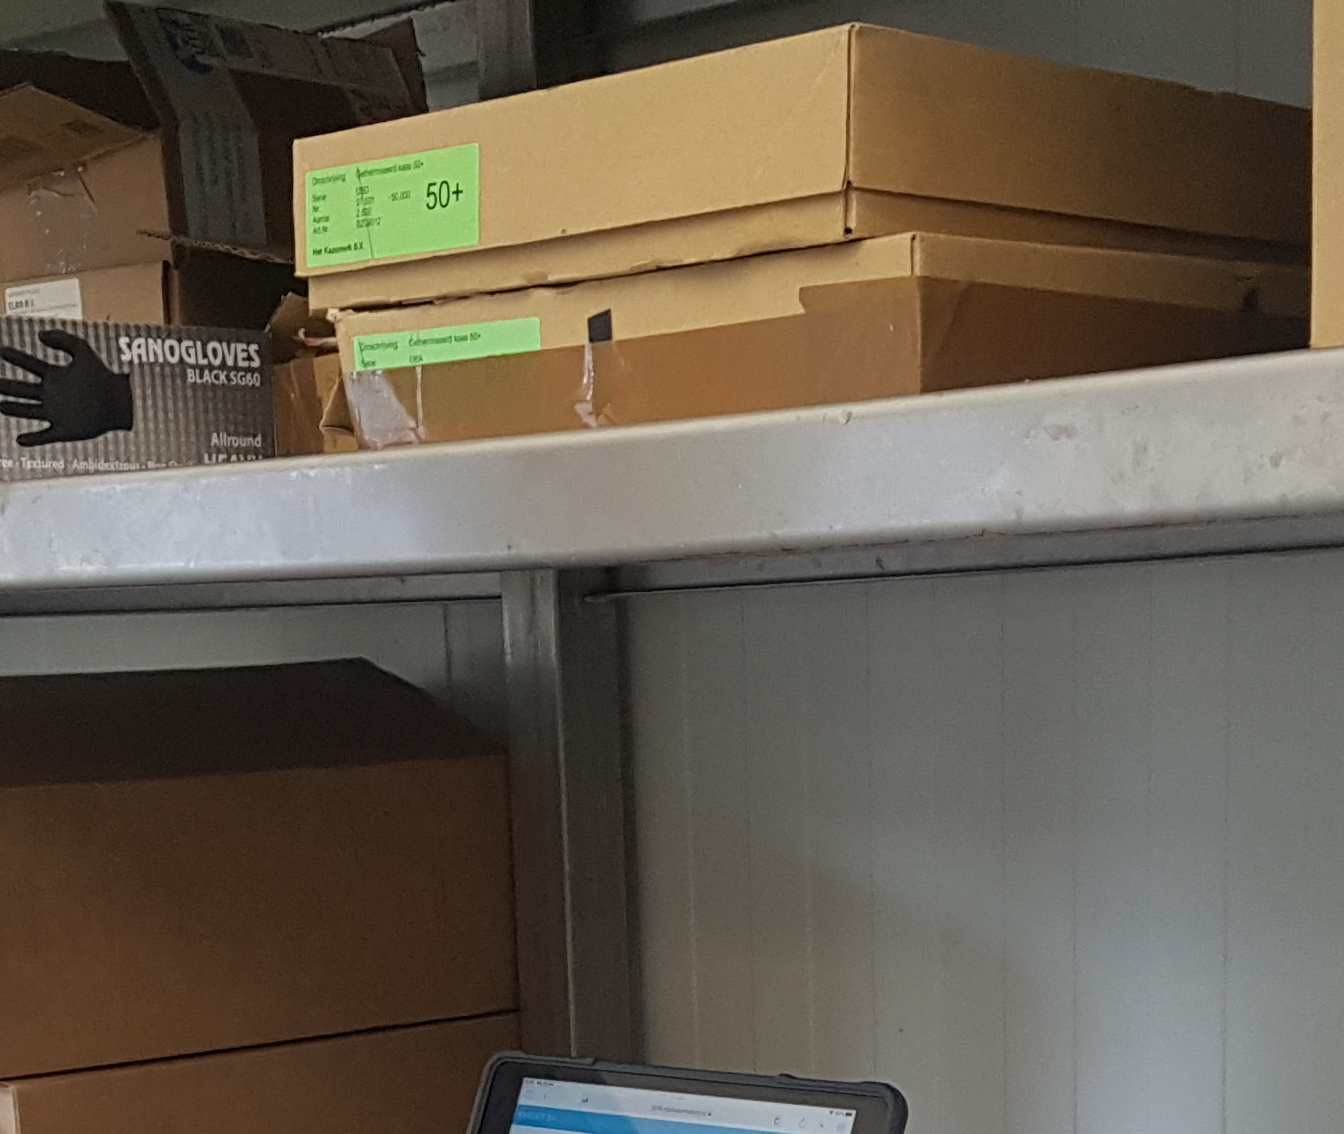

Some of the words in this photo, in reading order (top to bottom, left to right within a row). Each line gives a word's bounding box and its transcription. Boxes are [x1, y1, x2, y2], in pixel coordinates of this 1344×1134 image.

[425, 180, 463, 210] 50+
[118, 336, 261, 368] SANOGLOVES
[187, 368, 228, 384] BLACK
[229, 370, 261, 387] SG60
[210, 432, 262, 448] Allround
[20, 457, 65, 469] Textured
